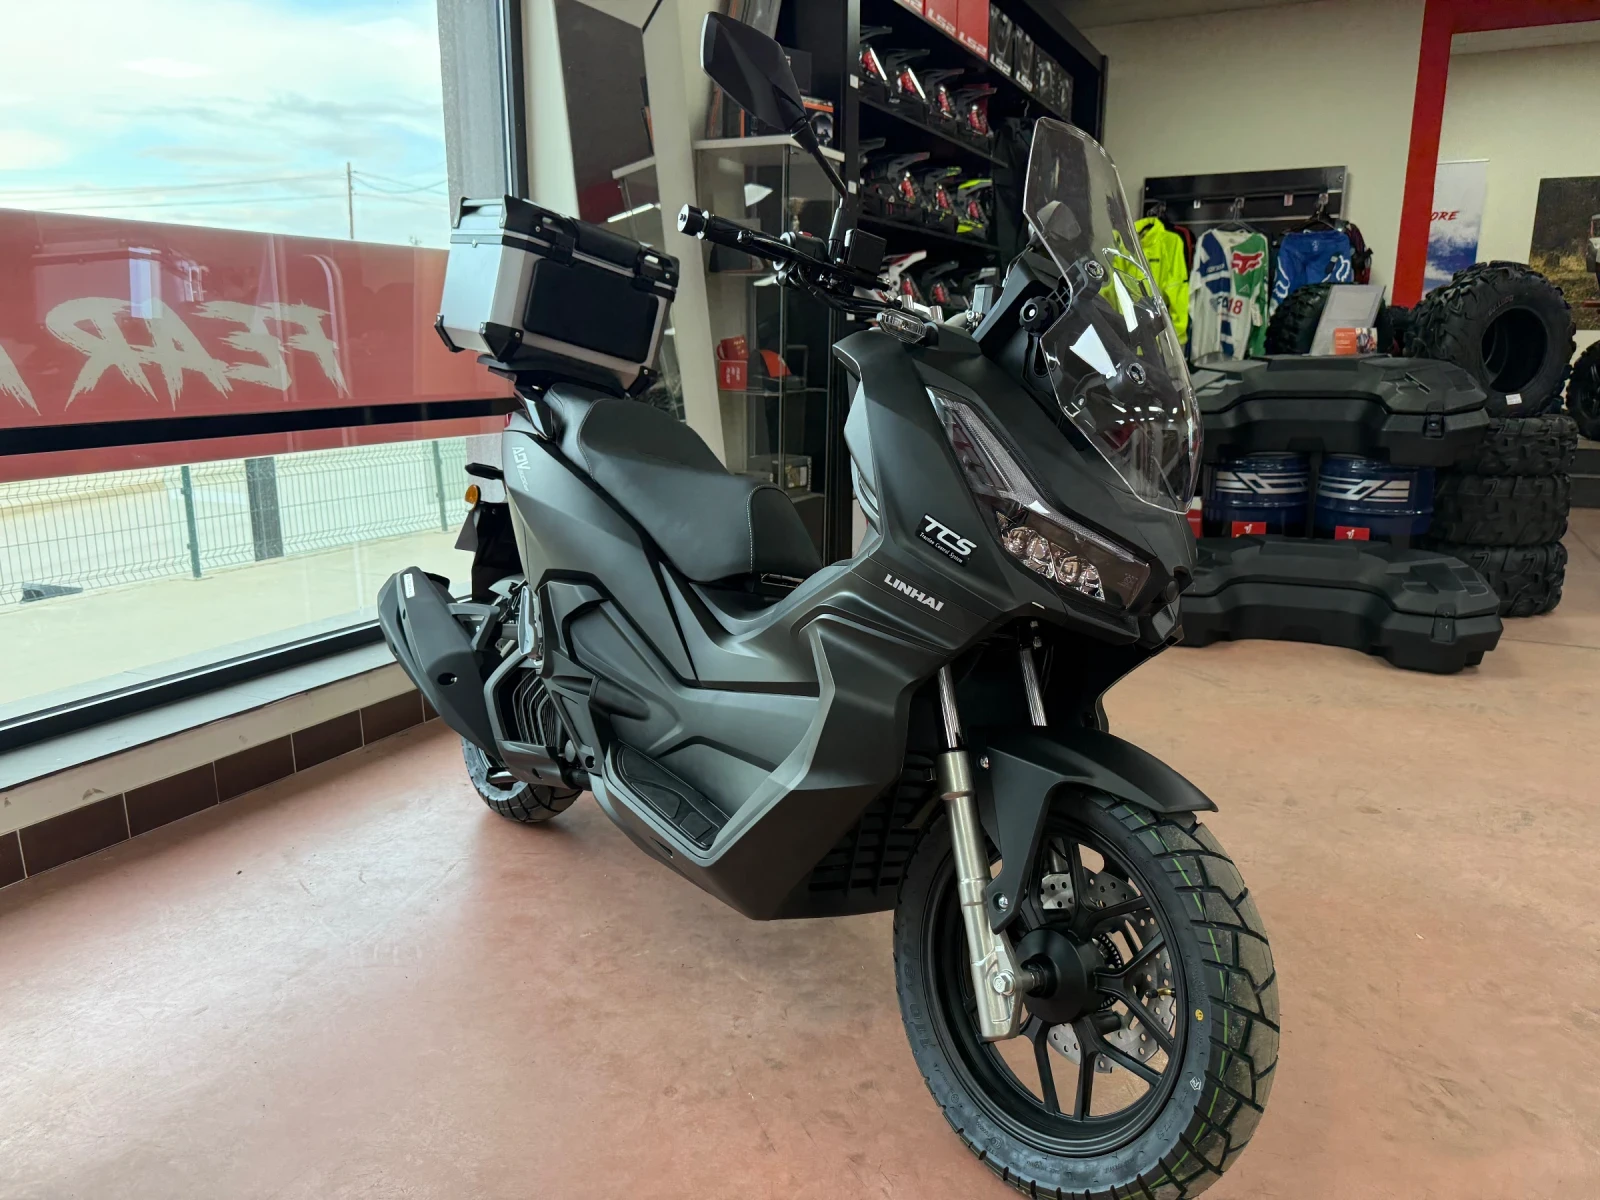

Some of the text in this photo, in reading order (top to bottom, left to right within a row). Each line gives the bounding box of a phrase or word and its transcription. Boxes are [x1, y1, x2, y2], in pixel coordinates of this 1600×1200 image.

[927, 8, 957, 36] LS2
[958, 31, 988, 57] LS2
[990, 53, 1012, 77] LS2
[1015, 70, 1033, 92] LS2
[512, 446, 531, 470] ADV
[924, 514, 978, 556] TCS
[934, 543, 951, 555] Control
[948, 552, 963, 564] System
[883, 573, 945, 612] LINHAI
